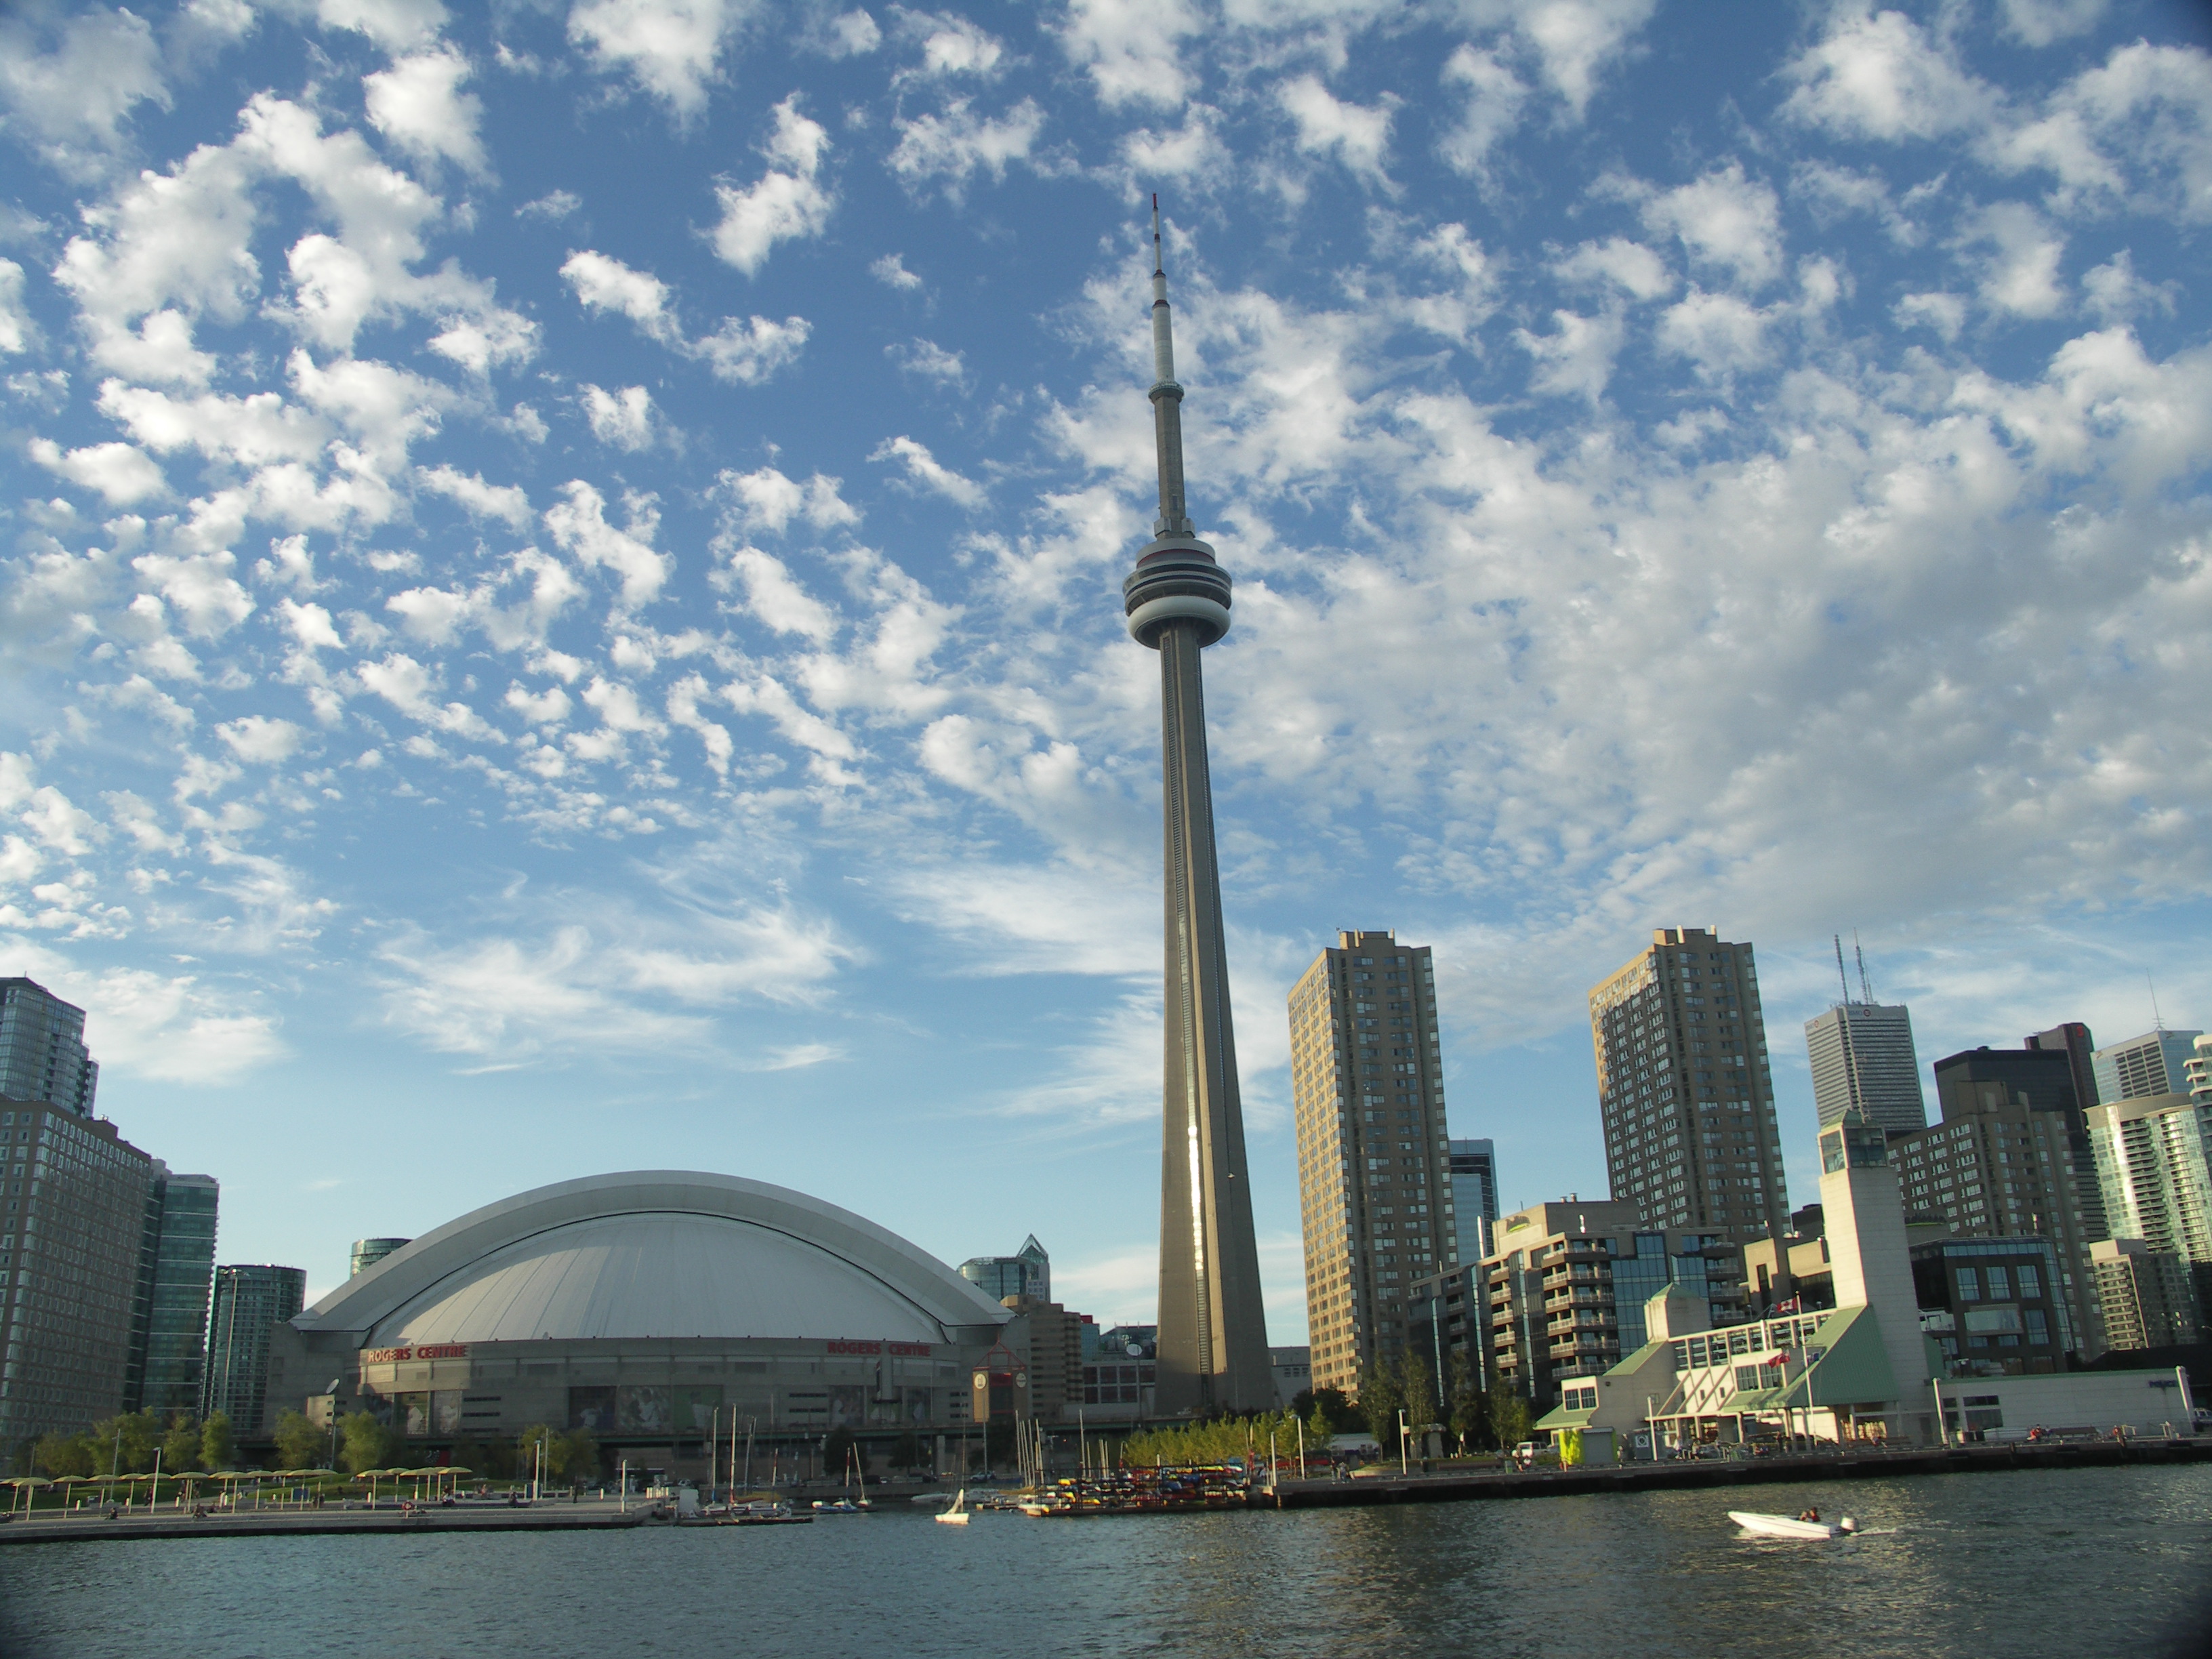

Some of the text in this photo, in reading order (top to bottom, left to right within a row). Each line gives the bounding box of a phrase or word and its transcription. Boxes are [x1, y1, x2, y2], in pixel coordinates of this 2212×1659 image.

[368, 1345, 467, 1362] ROGERS CENTRE
[827, 1341, 931, 1356] ROGERS CENTRE
